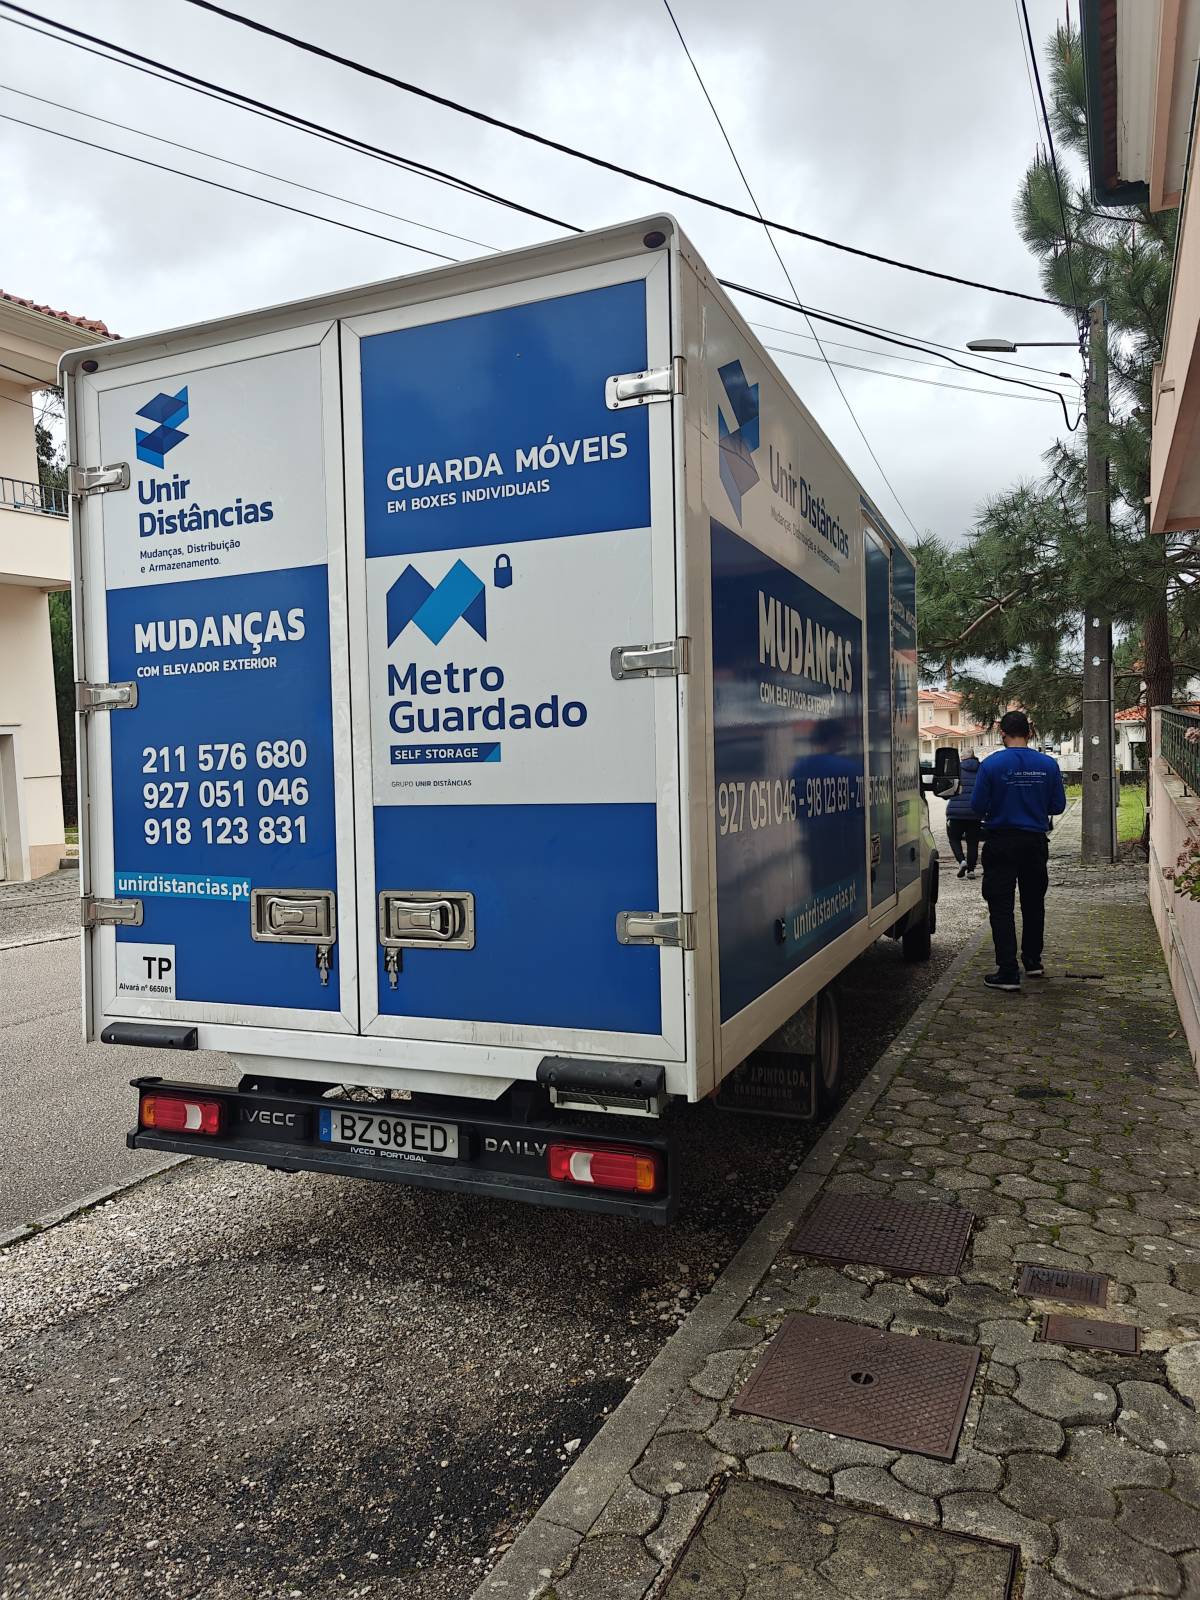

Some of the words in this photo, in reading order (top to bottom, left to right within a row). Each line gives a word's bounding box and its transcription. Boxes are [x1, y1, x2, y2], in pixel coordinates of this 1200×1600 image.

[386, 452, 503, 491] GUARDA
[515, 432, 628, 473] MÓVEIS
[138, 473, 190, 504] Unir
[387, 500, 406, 514] EM
[411, 492, 457, 510] BOXES
[462, 479, 550, 504] INDIVIDUAIS
[770, 445, 797, 509] Unir
[800, 476, 849, 560] Distâncias
[139, 498, 274, 538] Distâncias
[140, 547, 184, 560] Mudanças,
[187, 539, 241, 554] Distribuição
[149, 558, 221, 573] Armazenamento.
[134, 608, 305, 654] MUDANÇAS
[759, 590, 852, 706] MUDANÇAS
[137, 665, 160, 678] COM
[163, 660, 219, 676] ELEVADOR
[223, 657, 277, 671] EXTERIOR
[388, 662, 504, 696] Metro
[760, 682, 774, 704] COM
[389, 695, 588, 734] Guardado
[142, 745, 186, 774] 211
[198, 742, 247, 772] 576
[256, 739, 307, 769] 680
[395, 749, 421, 760] SELF
[425, 748, 479, 759] STORAGE
[143, 781, 190, 809] 927
[199, 780, 244, 808] 051
[257, 777, 309, 806] 046
[433, 778, 472, 787] DISTÂNCIAS
[719, 782, 745, 835] 927
[750, 780, 771, 830] 051
[775, 779, 797, 825] 046
[807, 778, 822, 818] 918
[824, 777, 835, 814] 123
[838, 776, 849, 811] 831
[144, 817, 191, 845] 918
[201, 816, 248, 845] 123
[258, 815, 307, 844] 831
[118, 875, 249, 900] unirdistancias.pt
[793, 880, 857, 941] unirdistancias.pt
[143, 956, 172, 980] TP
[119, 982, 139, 992] Alvará
[149, 984, 172, 994] 665081
[350, 1146, 376, 1156] IVECO
[380, 1151, 427, 1163] PORTUGAL
[485, 1137, 547, 1156] DAILY
